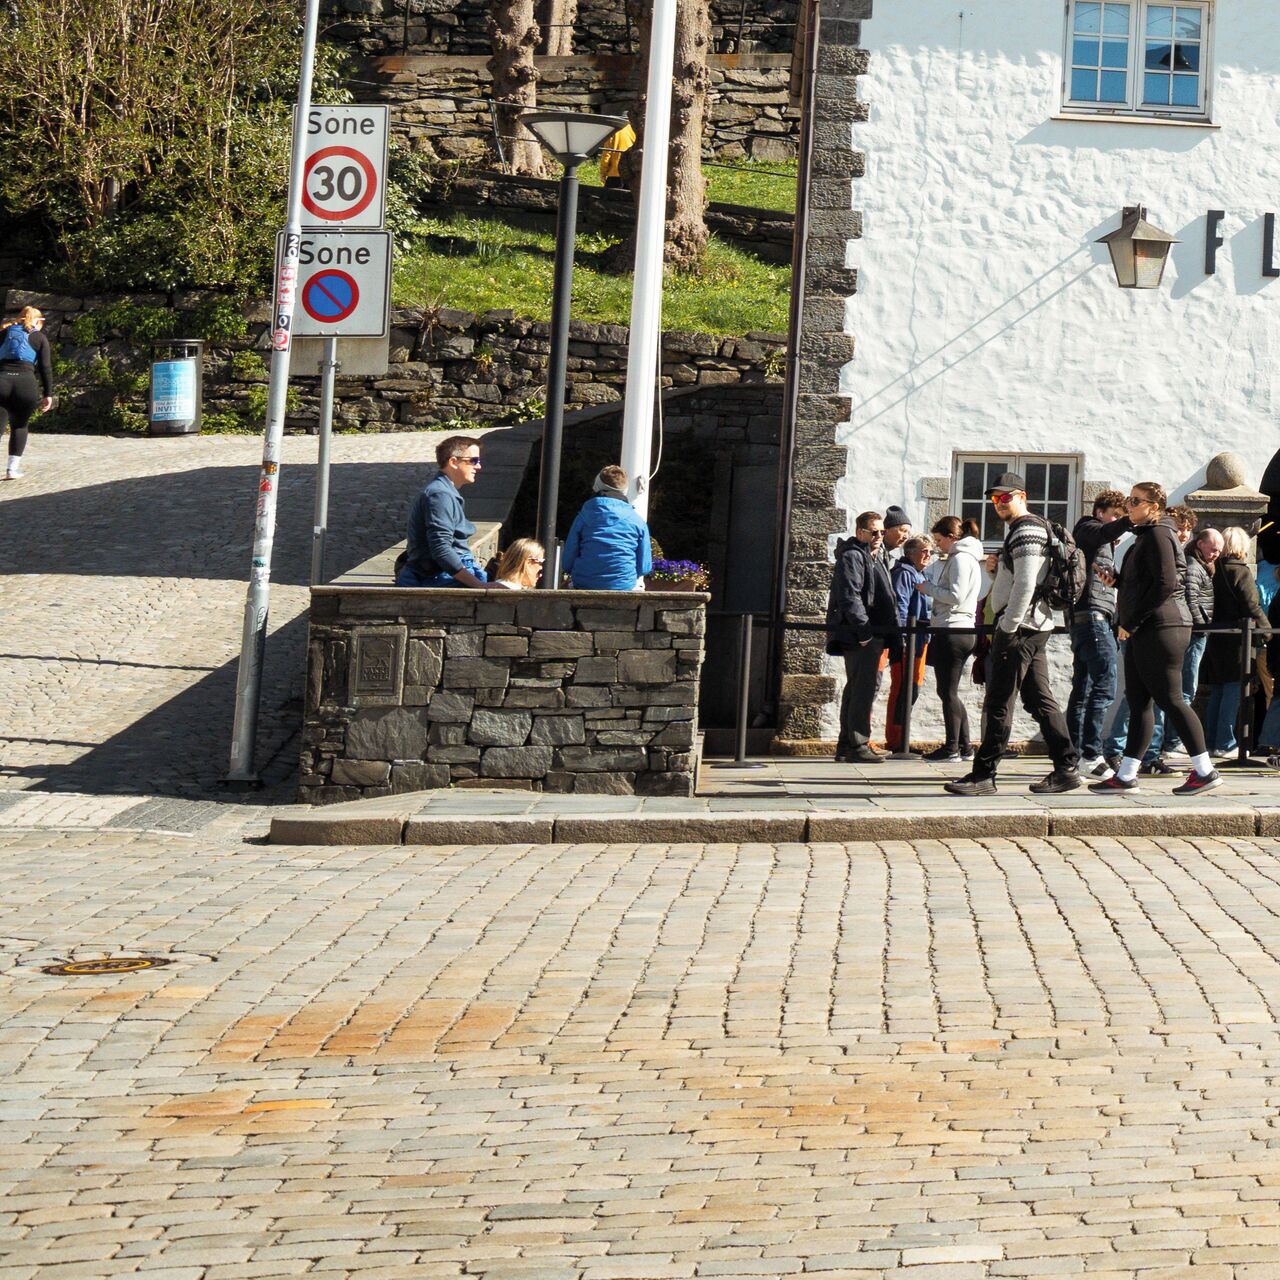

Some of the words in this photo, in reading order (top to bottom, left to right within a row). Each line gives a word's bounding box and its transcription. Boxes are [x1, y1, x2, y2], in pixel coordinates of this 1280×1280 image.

[307, 111, 375, 135] Sone
[312, 165, 362, 202] 30
[299, 240, 371, 265] Sone
